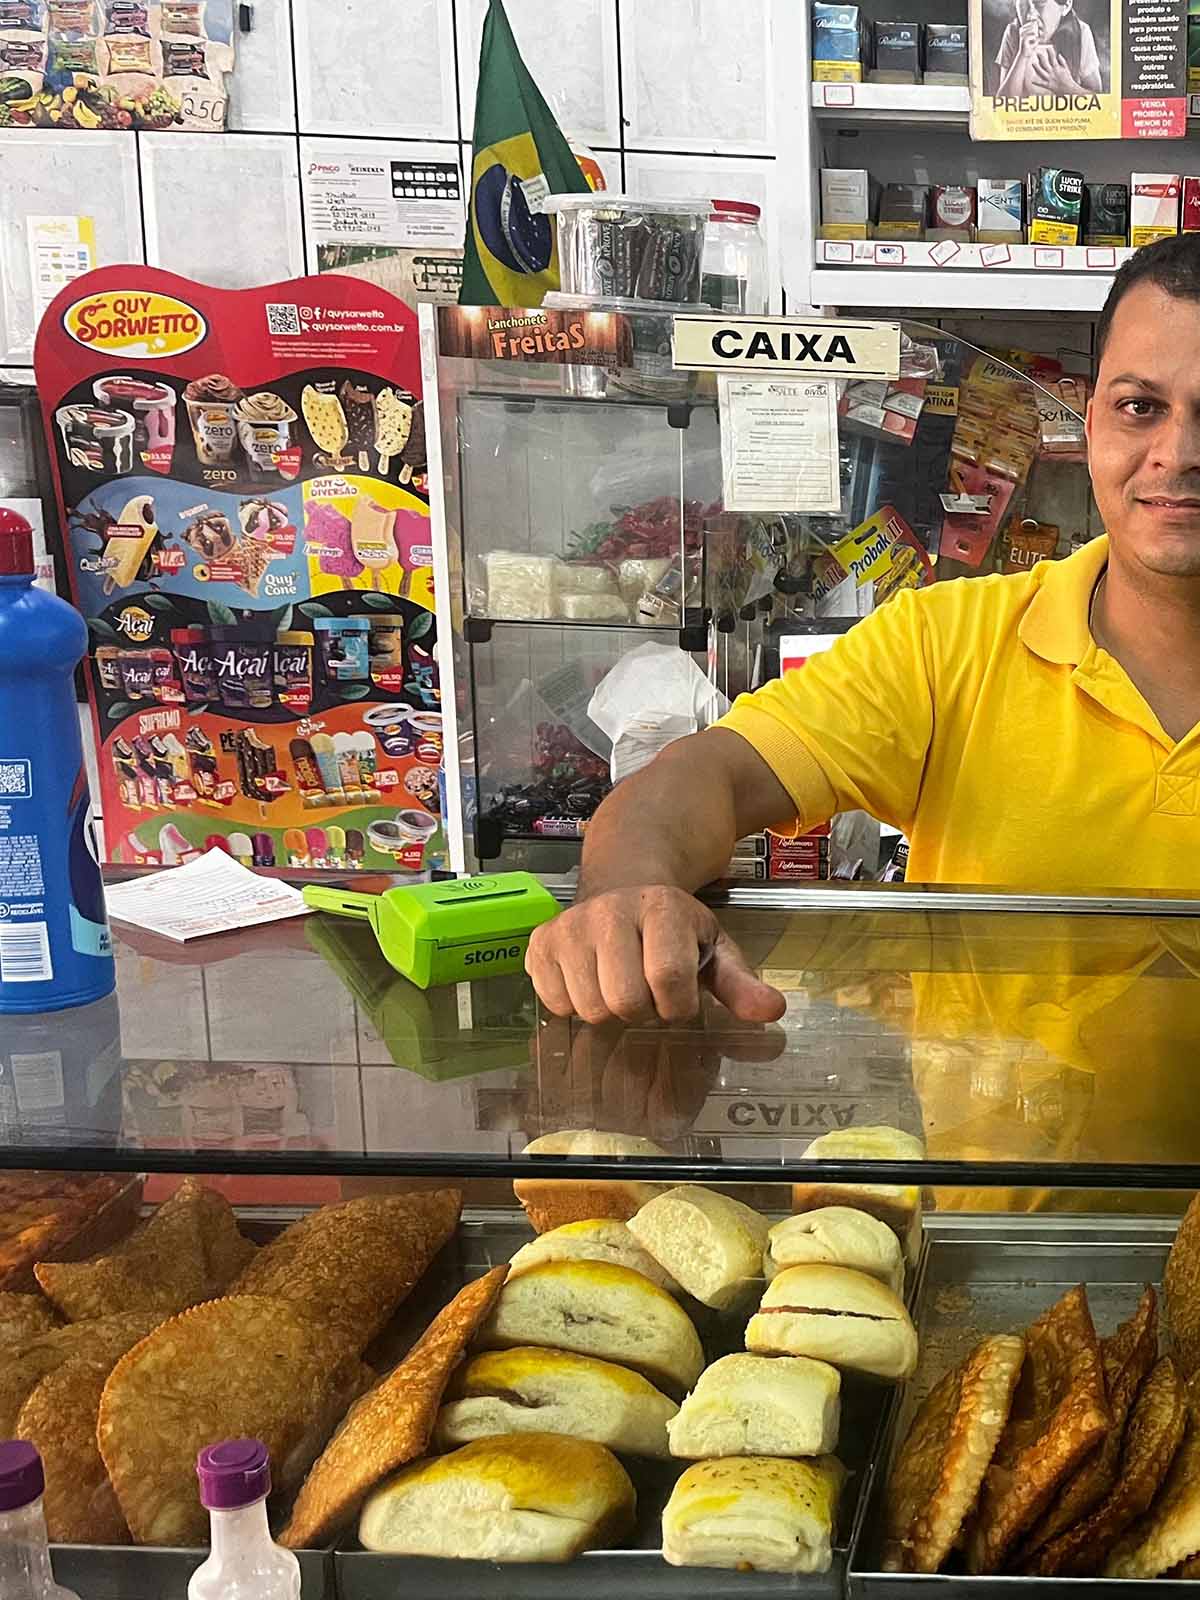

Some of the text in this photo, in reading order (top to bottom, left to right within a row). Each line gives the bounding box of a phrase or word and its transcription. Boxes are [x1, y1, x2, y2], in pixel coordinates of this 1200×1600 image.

[1137, 7, 1165, 15] produto
[1146, 26, 1179, 34] preservar
[1134, 54, 1167, 62] bronquite
[1138, 73, 1169, 81] doenças
[992, 94, 1102, 112] PREJUDICA
[1061, 176, 1083, 186] LUCKY
[1059, 184, 1082, 194] STRIKE
[113, 297, 152, 314] QUY
[76, 299, 199, 343] SORWETTO
[487, 314, 548, 331] Lanchonete
[711, 329, 857, 365] CAIXA
[204, 425, 233, 437] zero
[252, 442, 282, 454] zero
[202, 469, 238, 481] zero
[312, 479, 333, 488] QUY
[311, 486, 358, 497] DIVERSÃO
[849, 533, 892, 579] Probak
[1010, 547, 1047, 565] ELITE
[265, 574, 294, 587] Quy
[265, 584, 297, 596] Cone
[113, 615, 155, 635] Açaí
[213, 650, 270, 680] Açaí
[463, 942, 521, 965] stone
